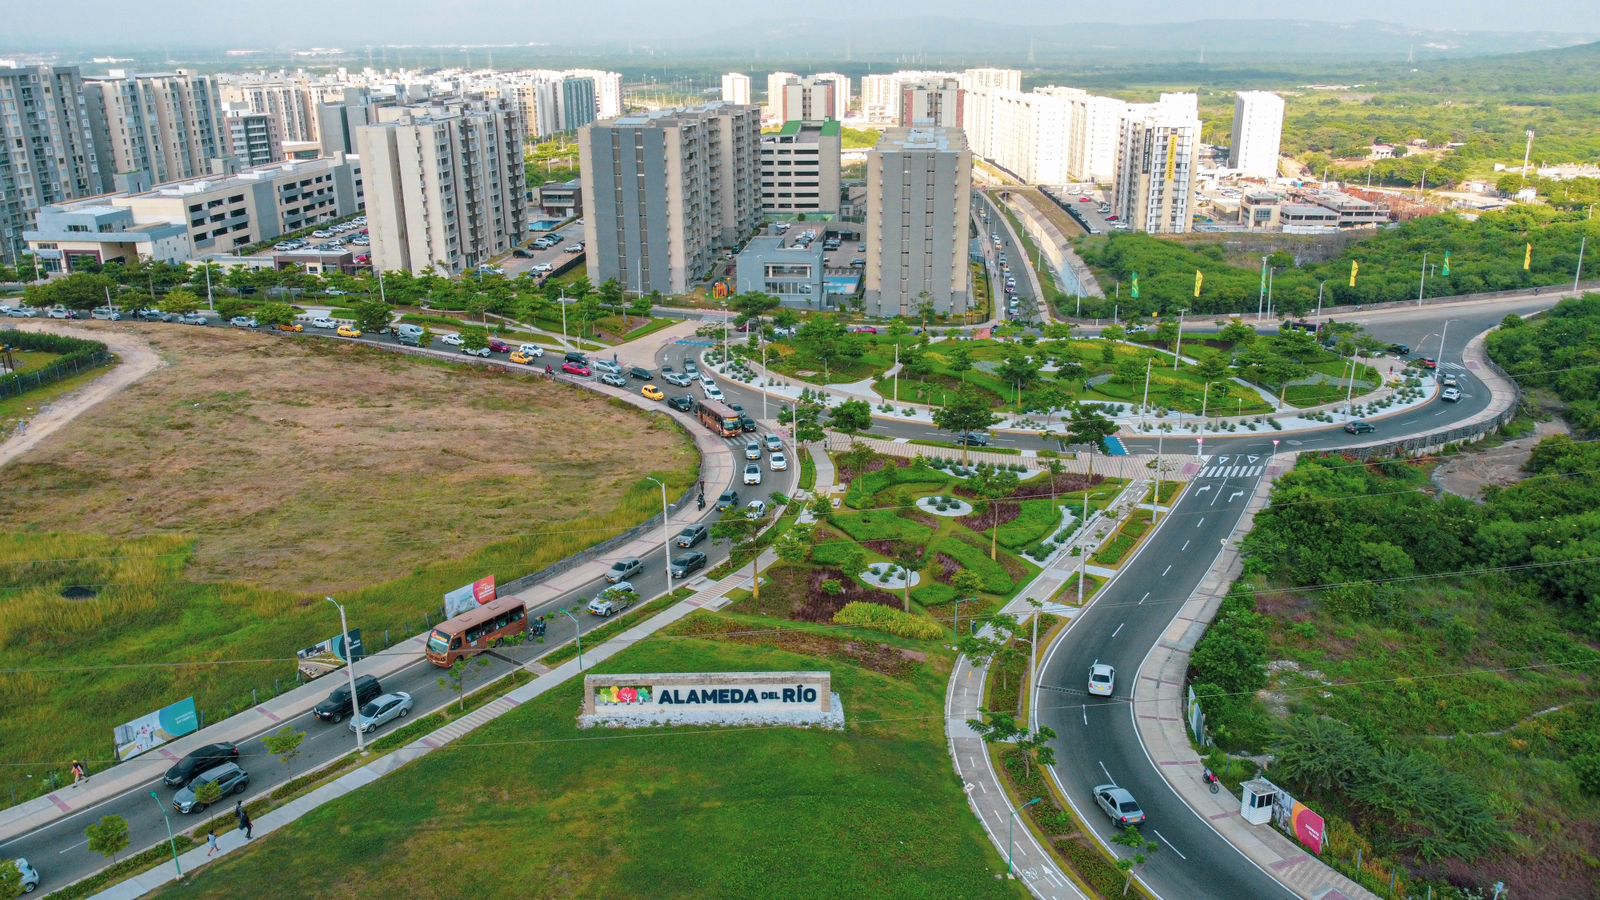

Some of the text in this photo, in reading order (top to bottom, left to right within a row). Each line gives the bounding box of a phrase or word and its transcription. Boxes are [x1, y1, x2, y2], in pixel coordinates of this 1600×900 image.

[658, 684, 817, 704] ALAMEDA DEL RÍO
